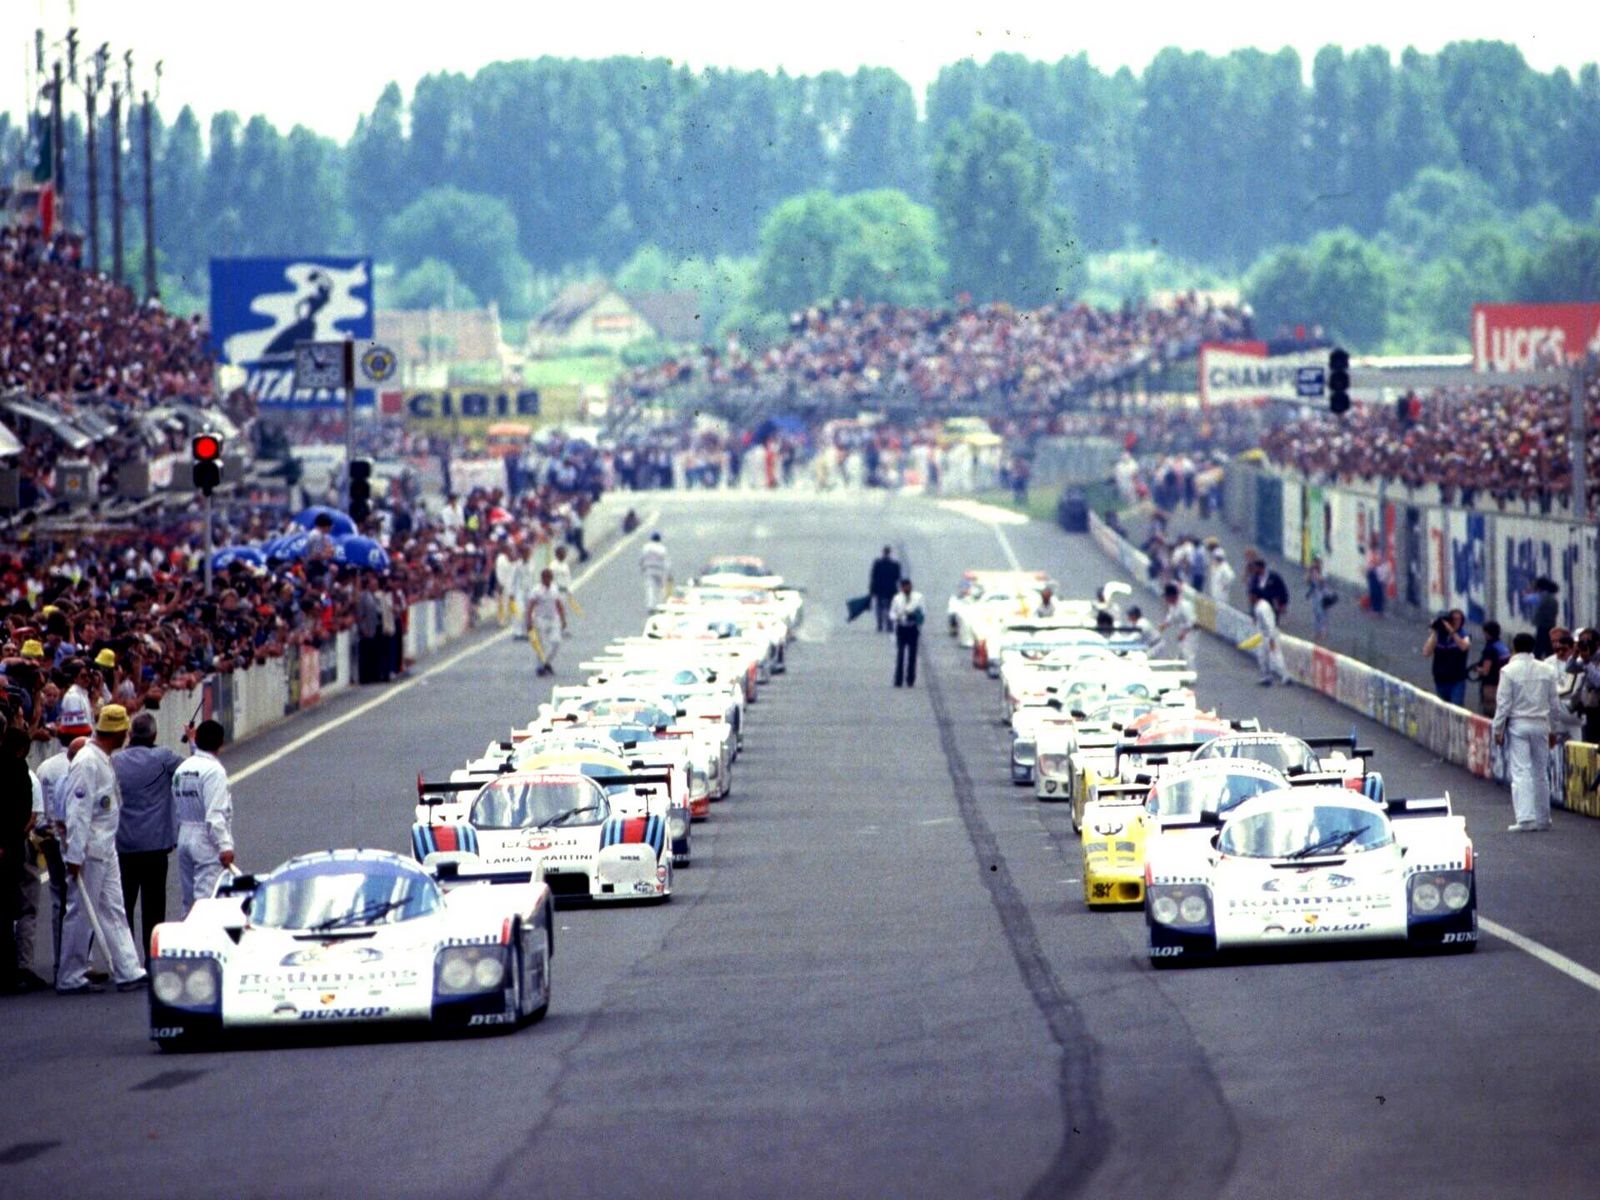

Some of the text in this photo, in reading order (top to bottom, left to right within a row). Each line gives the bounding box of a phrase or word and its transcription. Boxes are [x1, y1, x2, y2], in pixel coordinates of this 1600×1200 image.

[486, 854, 532, 865] LANCIA
[542, 852, 593, 863] MARTINI
[1288, 922, 1372, 935] DUNLOP
[299, 1006, 391, 1020] DUNLOP
